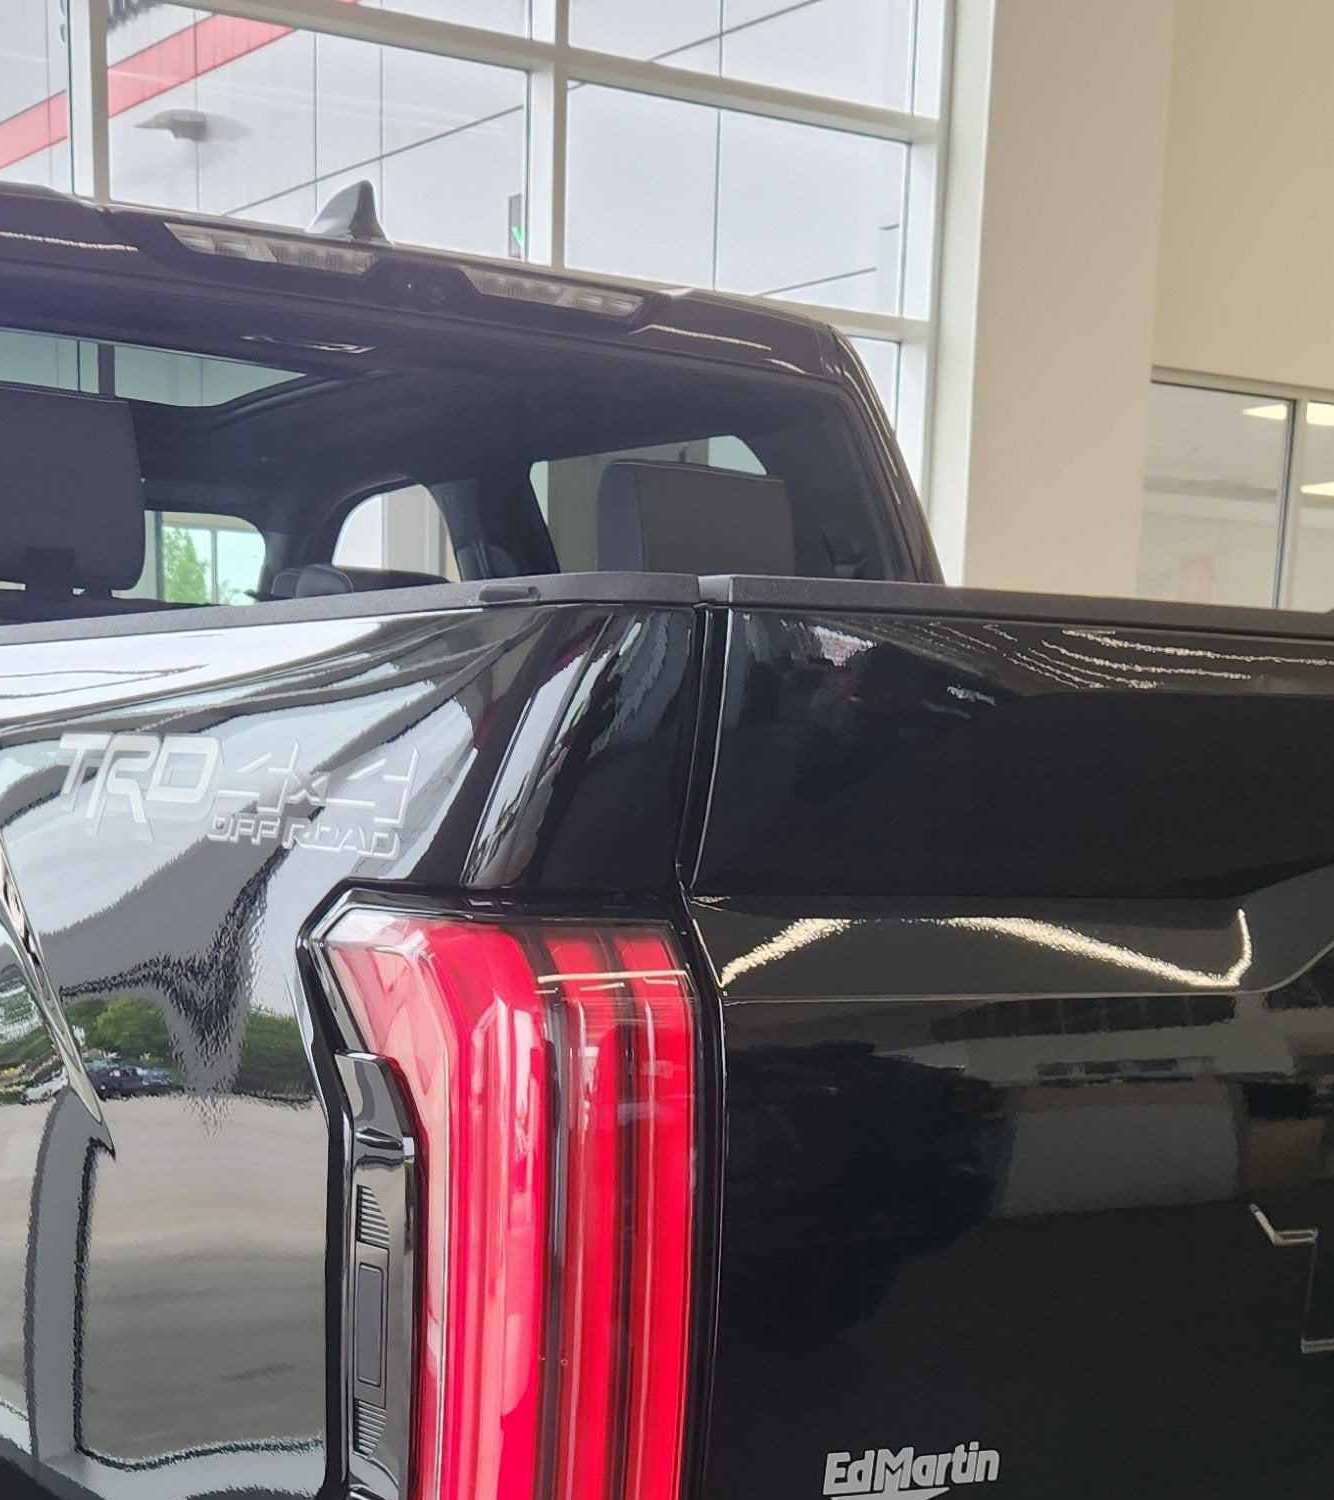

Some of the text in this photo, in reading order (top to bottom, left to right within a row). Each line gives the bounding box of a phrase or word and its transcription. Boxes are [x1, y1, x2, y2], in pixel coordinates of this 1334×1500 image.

[59, 732, 224, 841] TRD
[206, 812, 400, 861] OFF ROAD
